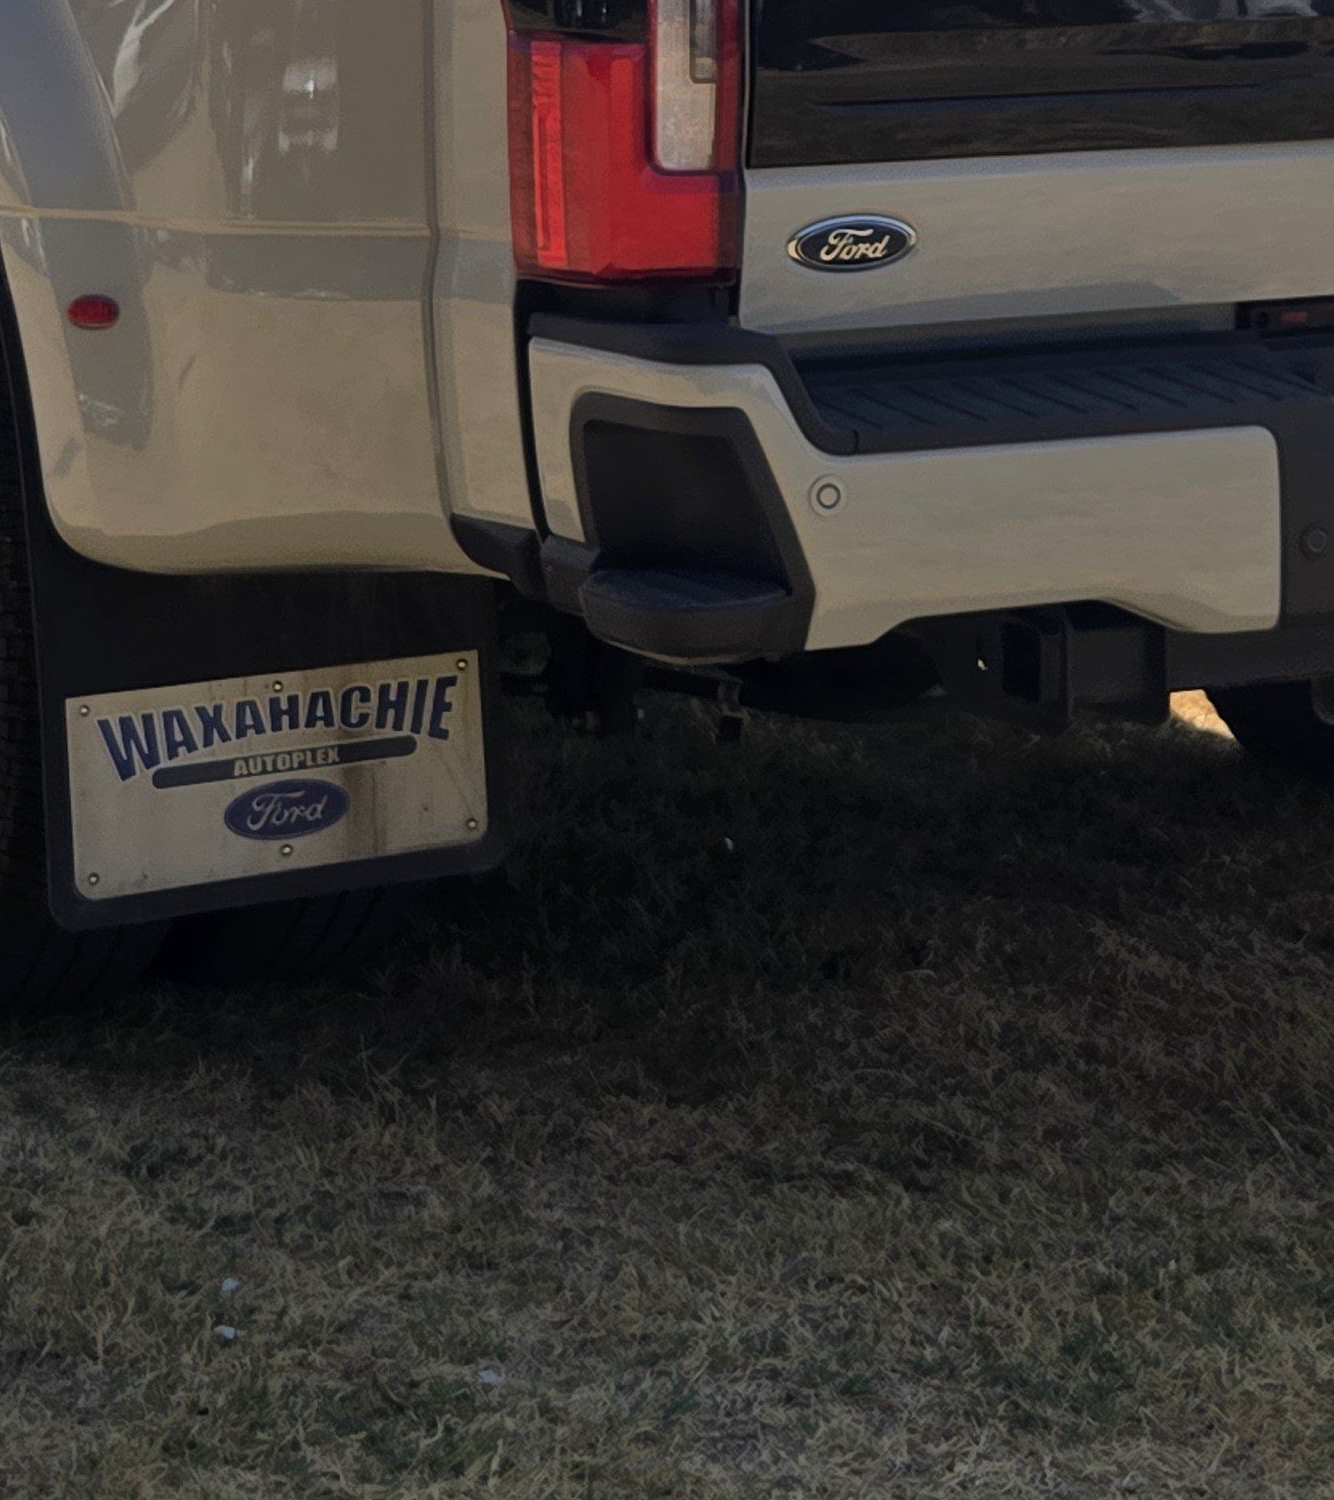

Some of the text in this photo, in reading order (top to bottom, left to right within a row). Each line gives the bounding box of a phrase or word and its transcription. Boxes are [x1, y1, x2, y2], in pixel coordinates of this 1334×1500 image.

[820, 228, 890, 262] Ford
[97, 676, 458, 781] WAXAHACHIE
[234, 748, 340, 777] AUTOPLEX
[247, 791, 324, 831] Ford
